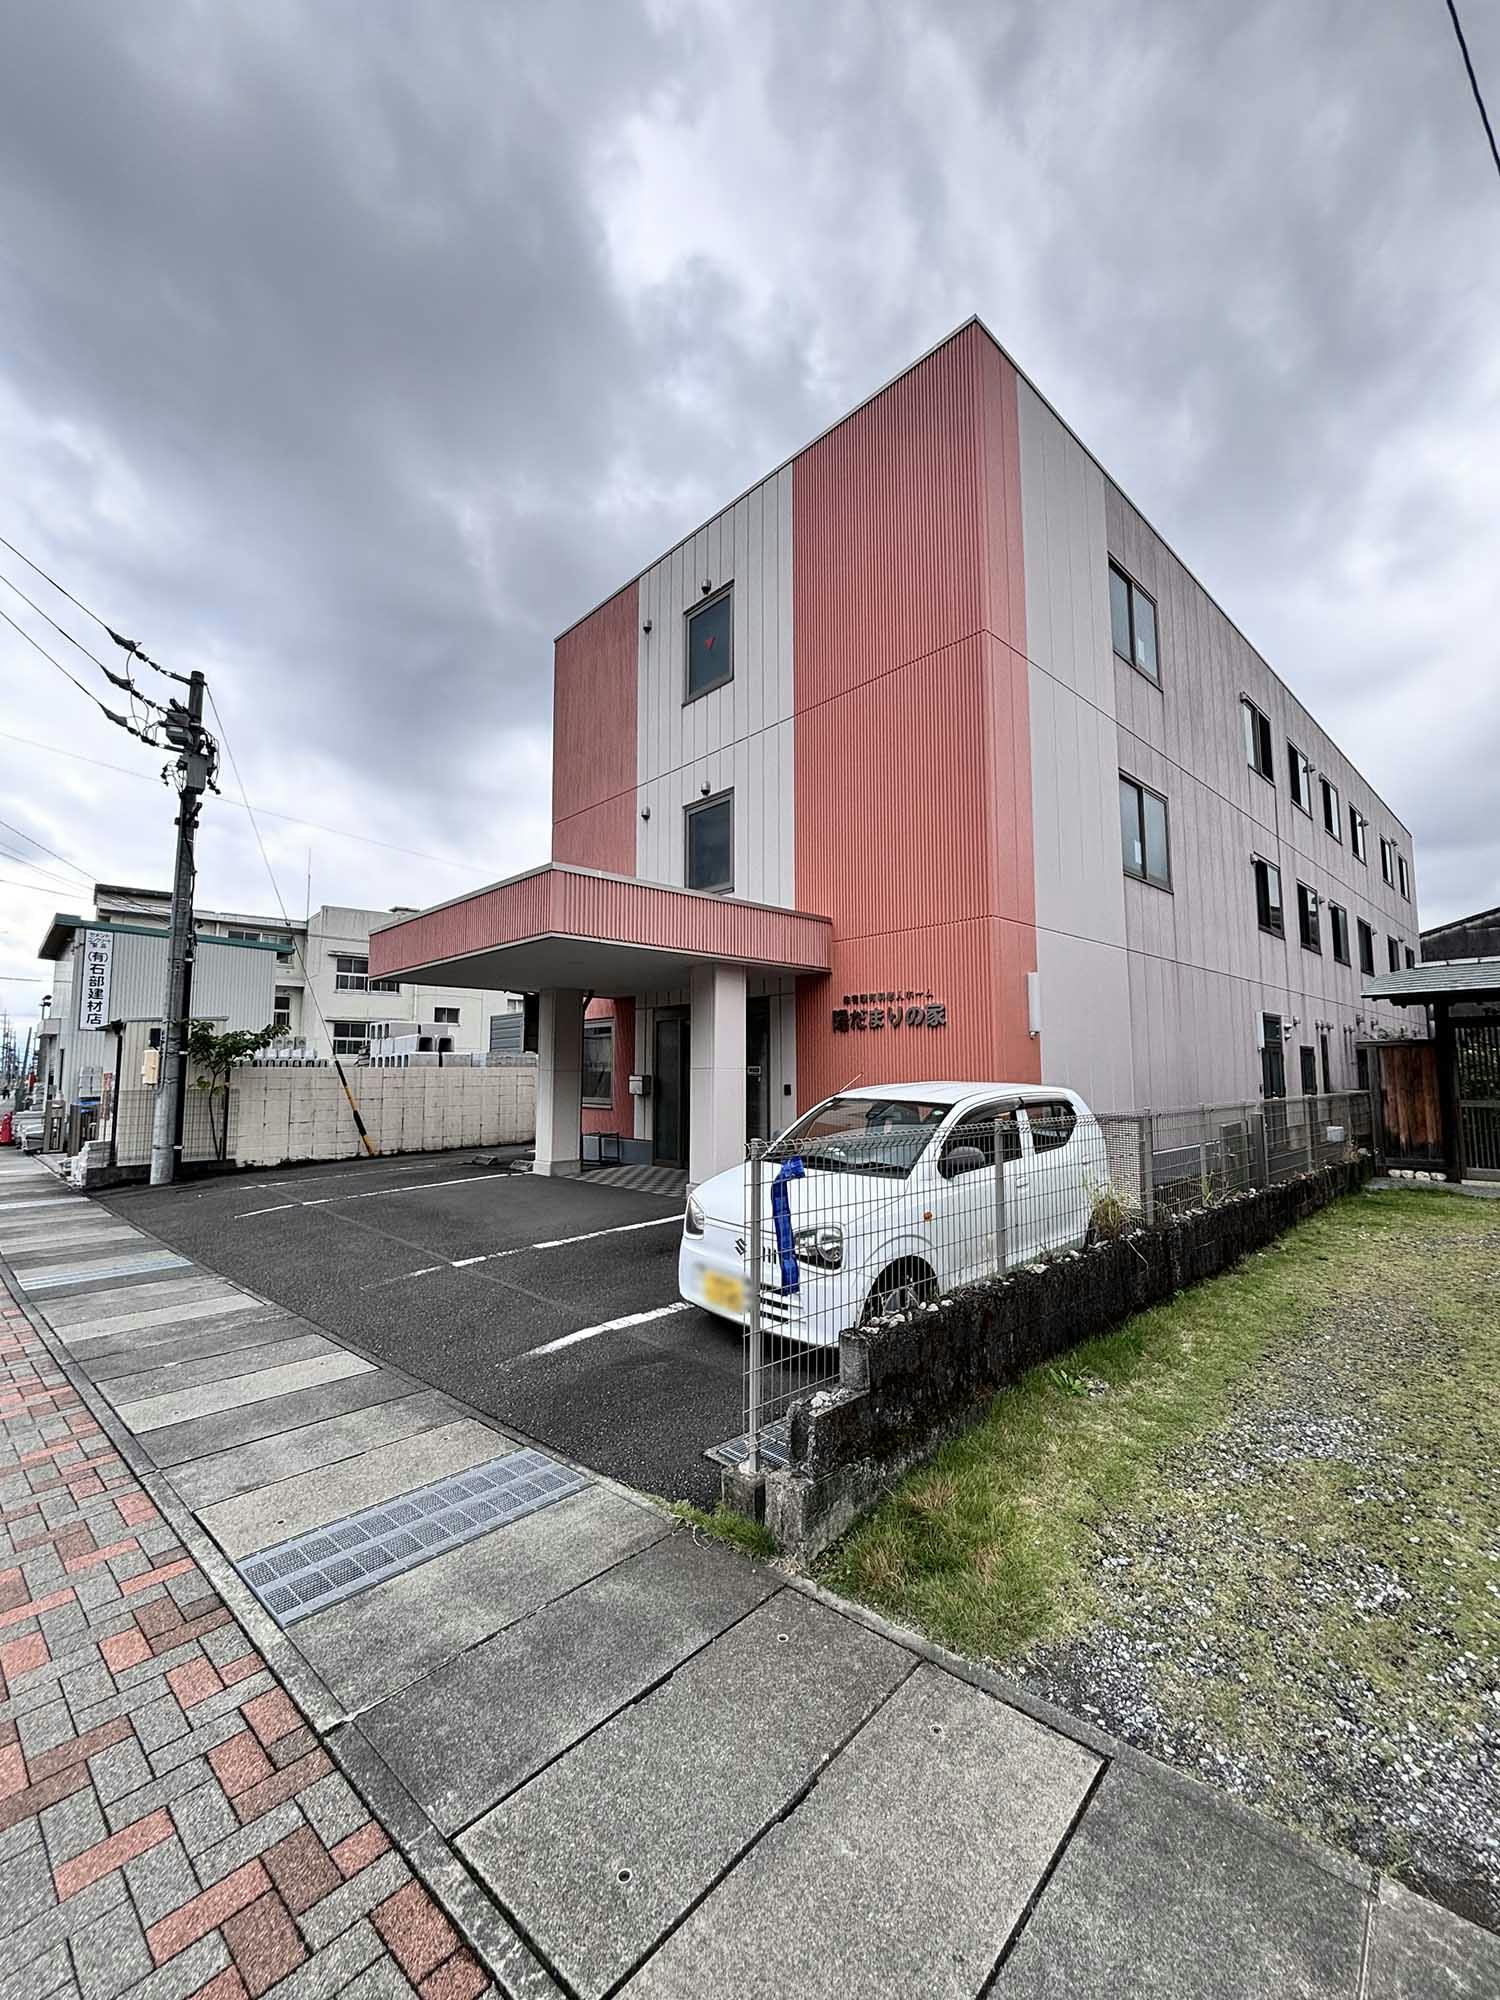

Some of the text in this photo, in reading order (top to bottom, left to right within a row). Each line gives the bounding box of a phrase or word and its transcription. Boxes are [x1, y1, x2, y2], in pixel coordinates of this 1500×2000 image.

[86, 951, 108, 1025] (有)石部建材店
